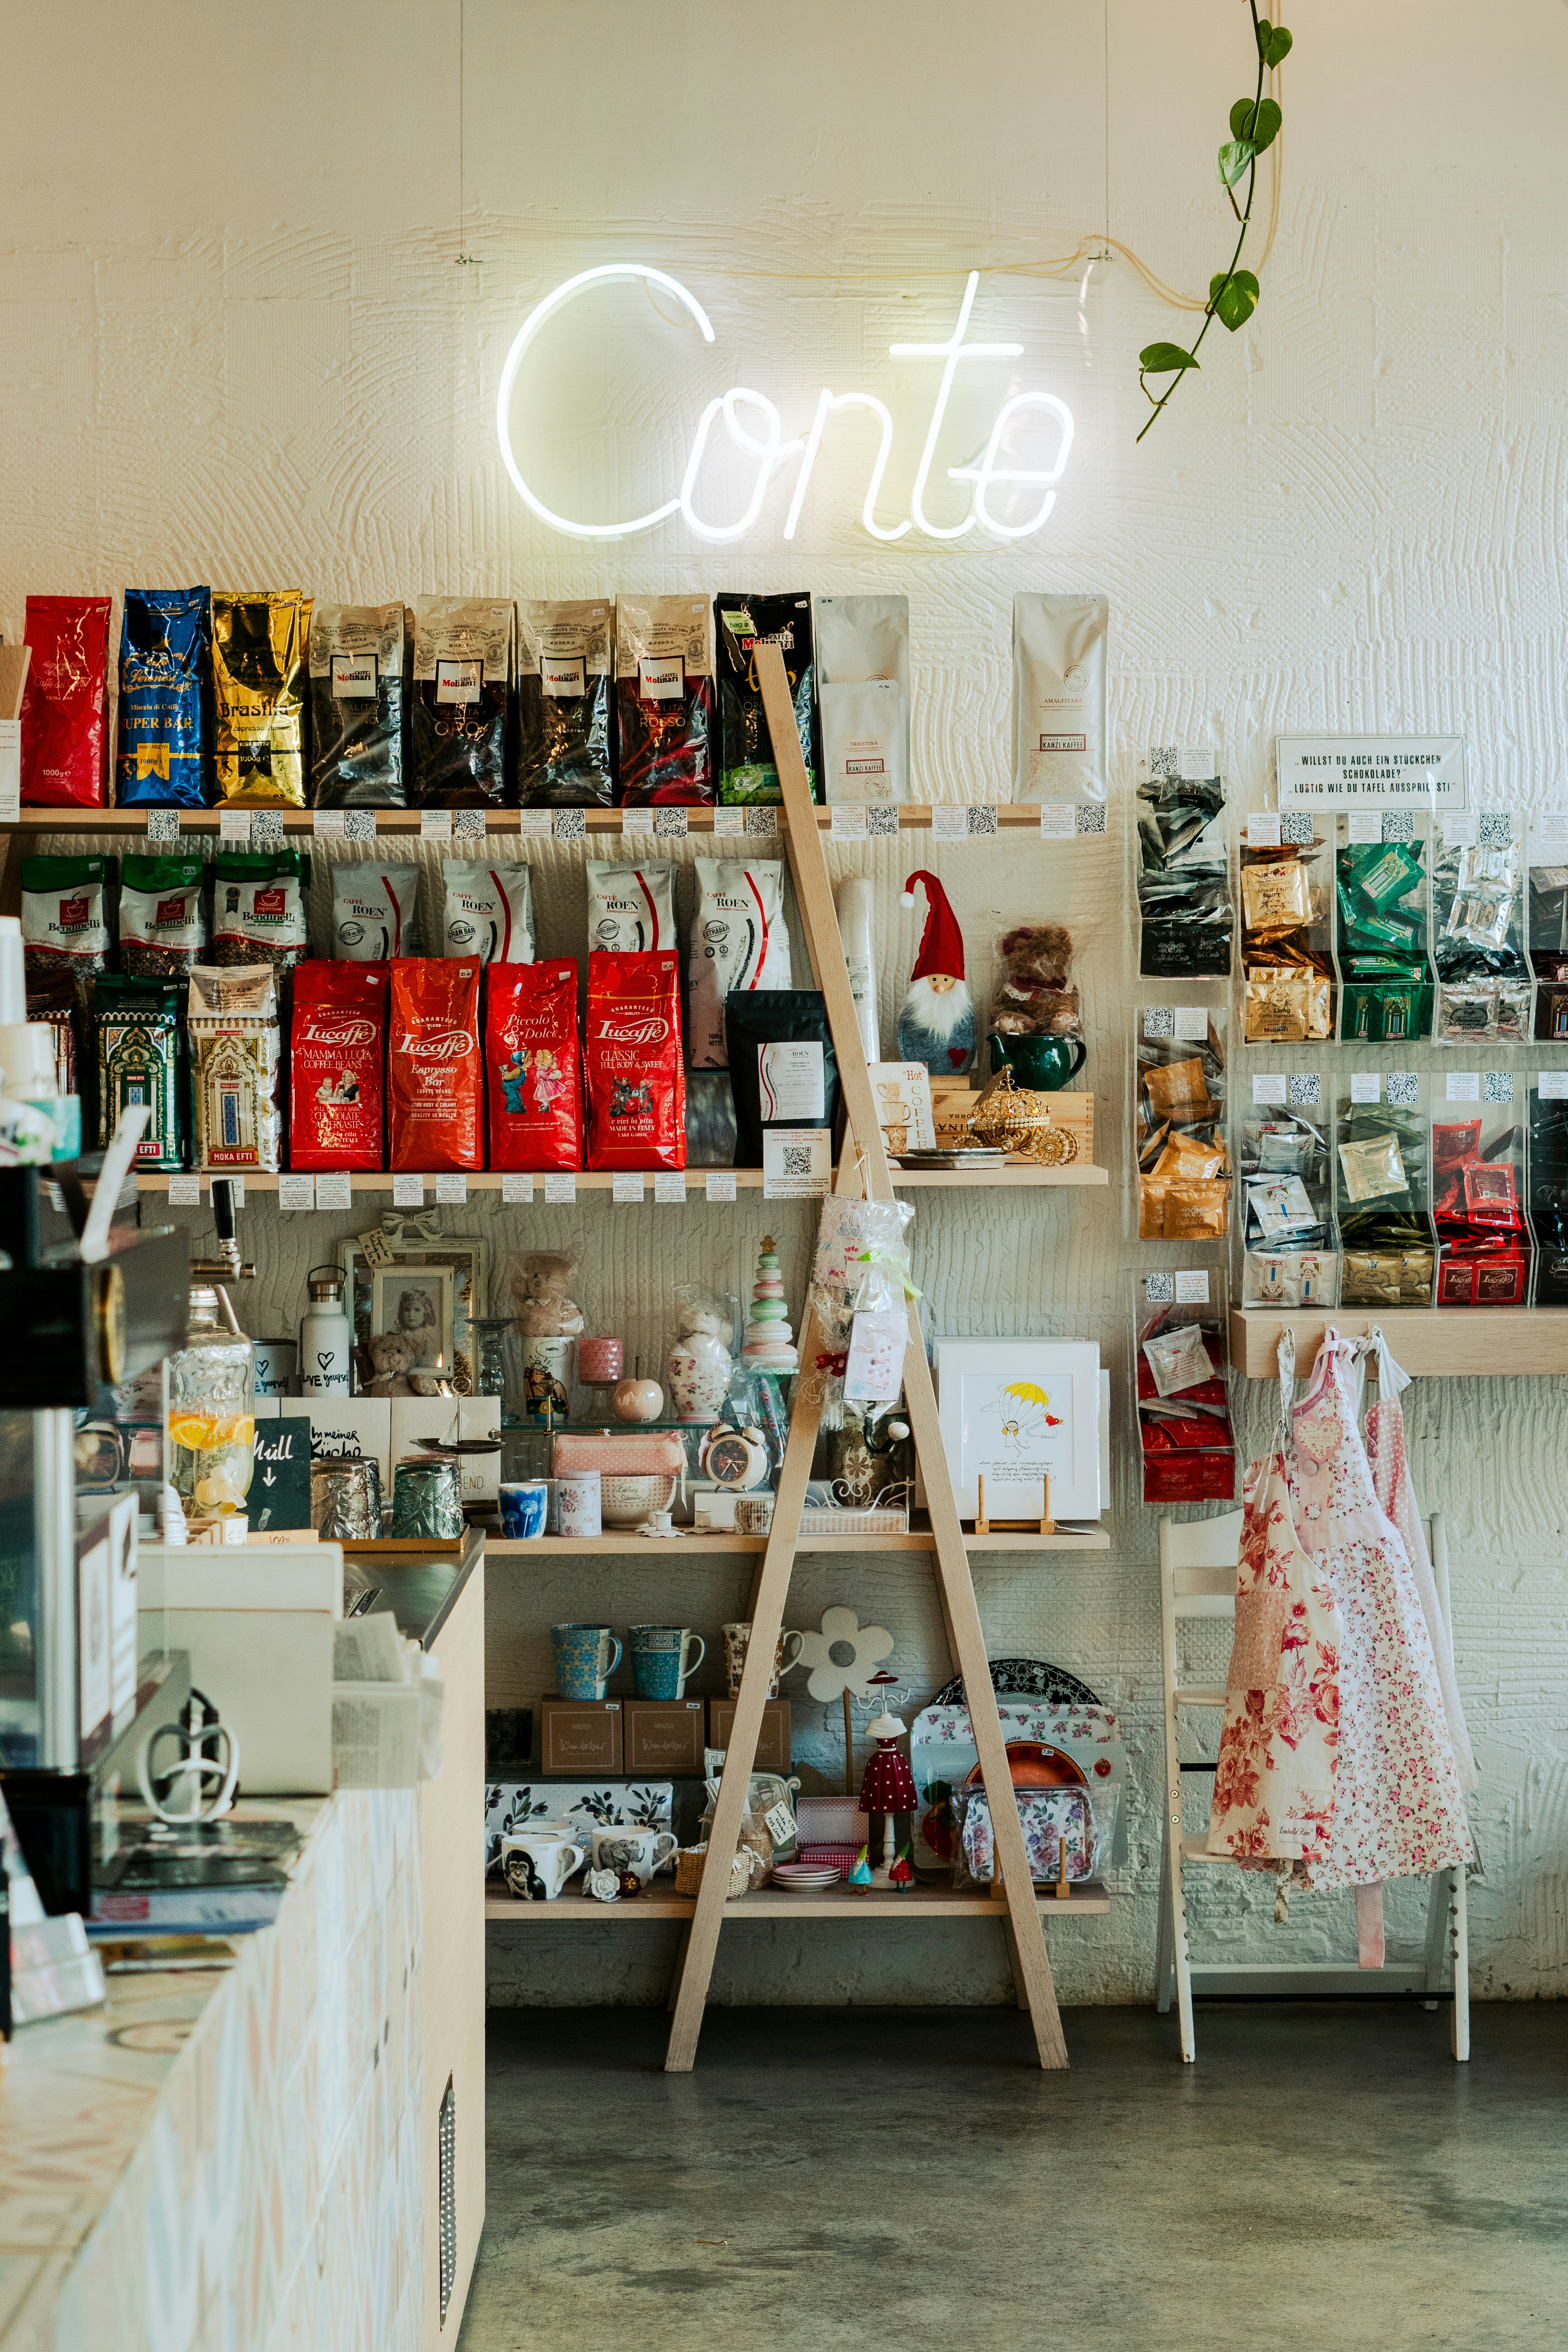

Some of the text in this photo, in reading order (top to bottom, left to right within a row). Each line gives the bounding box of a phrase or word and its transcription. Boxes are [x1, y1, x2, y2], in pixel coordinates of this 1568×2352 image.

[497, 264, 1074, 541] Conte
[130, 668, 178, 684] Veronesi
[337, 673, 371, 681] Molinari
[546, 674, 580, 682] Molinari
[645, 675, 679, 684] Molinari
[442, 678, 476, 687] Molinari
[220, 702, 289, 718] Brasilia
[120, 717, 193, 730] SUPER BAR
[640, 717, 686, 728] ROSSO
[435, 721, 479, 736] ORO
[239, 755, 261, 763] 1000g
[1336, 756, 1346, 765] DU
[1351, 756, 1372, 765] AUCH
[1376, 755, 1389, 765] EIN
[1393, 754, 1442, 765] STÜCKCHEN
[42, 769, 64, 778] 1000g
[1328, 783, 1343, 793] WIE
[1347, 783, 1357, 793] DU
[1361, 783, 1385, 793] TAFEL
[462, 899, 493, 911] ROEN
[607, 901, 639, 910] ROEN
[717, 898, 749, 908] ROEN
[242, 911, 295, 922] Bendinelli
[352, 905, 384, 917] ROEN
[48, 918, 100, 932] Bendinelli
[145, 915, 196, 931] Bendinelli
[447, 930, 464, 939] GRAN
[703, 926, 730, 938] EXTRABAR
[611, 1005, 654, 1013] GUARANTEED
[411, 1016, 458, 1025] GUARANTEED
[507, 1014, 550, 1026] Piccolo
[525, 1027, 558, 1039] Dolce
[594, 1017, 669, 1045] Lucaffé
[395, 1030, 474, 1061] Lucaffé
[304, 1050, 371, 1060] MAMMA LUCIA
[600, 1050, 640, 1061] CLASSIC
[304, 1060, 362, 1069] COFFEE BEANS
[410, 1064, 458, 1076] Espresso
[641, 1060, 662, 1069] SWEET
[424, 1076, 444, 1086] Bar
[315, 1112, 360, 1121] CHOCOLATE
[911, 1086, 928, 1150] COFFEE
[139, 1145, 156, 1154] EFTI
[236, 1152, 253, 1160] EFTI
[261, 1376, 289, 1395] yourself
